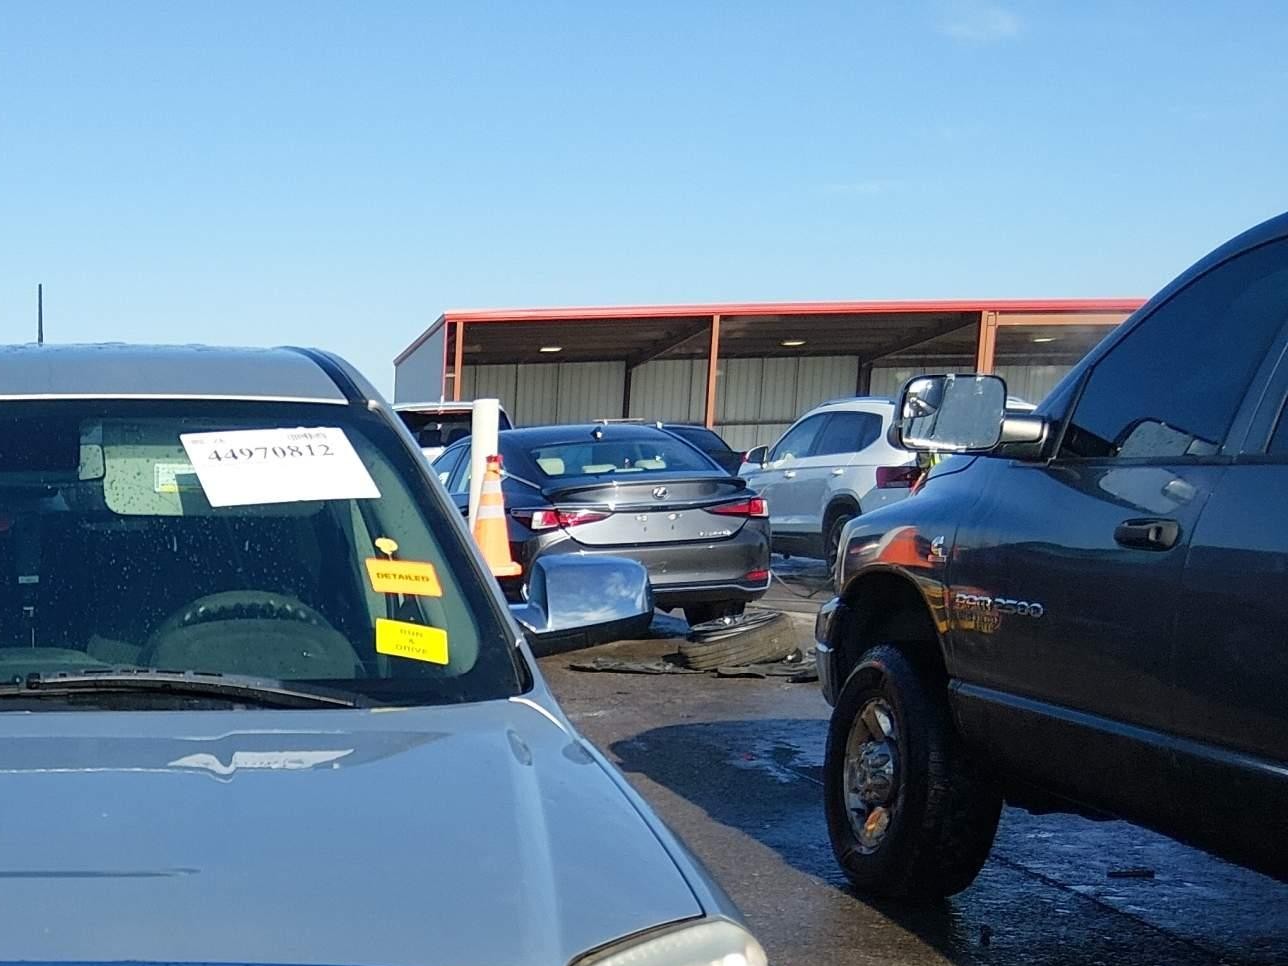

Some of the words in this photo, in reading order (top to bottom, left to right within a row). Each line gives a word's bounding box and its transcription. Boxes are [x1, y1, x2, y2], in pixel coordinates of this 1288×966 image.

[208, 443, 335, 462] 44970812
[376, 572, 430, 583] DETAILED
[994, 597, 1045, 618] 2500
